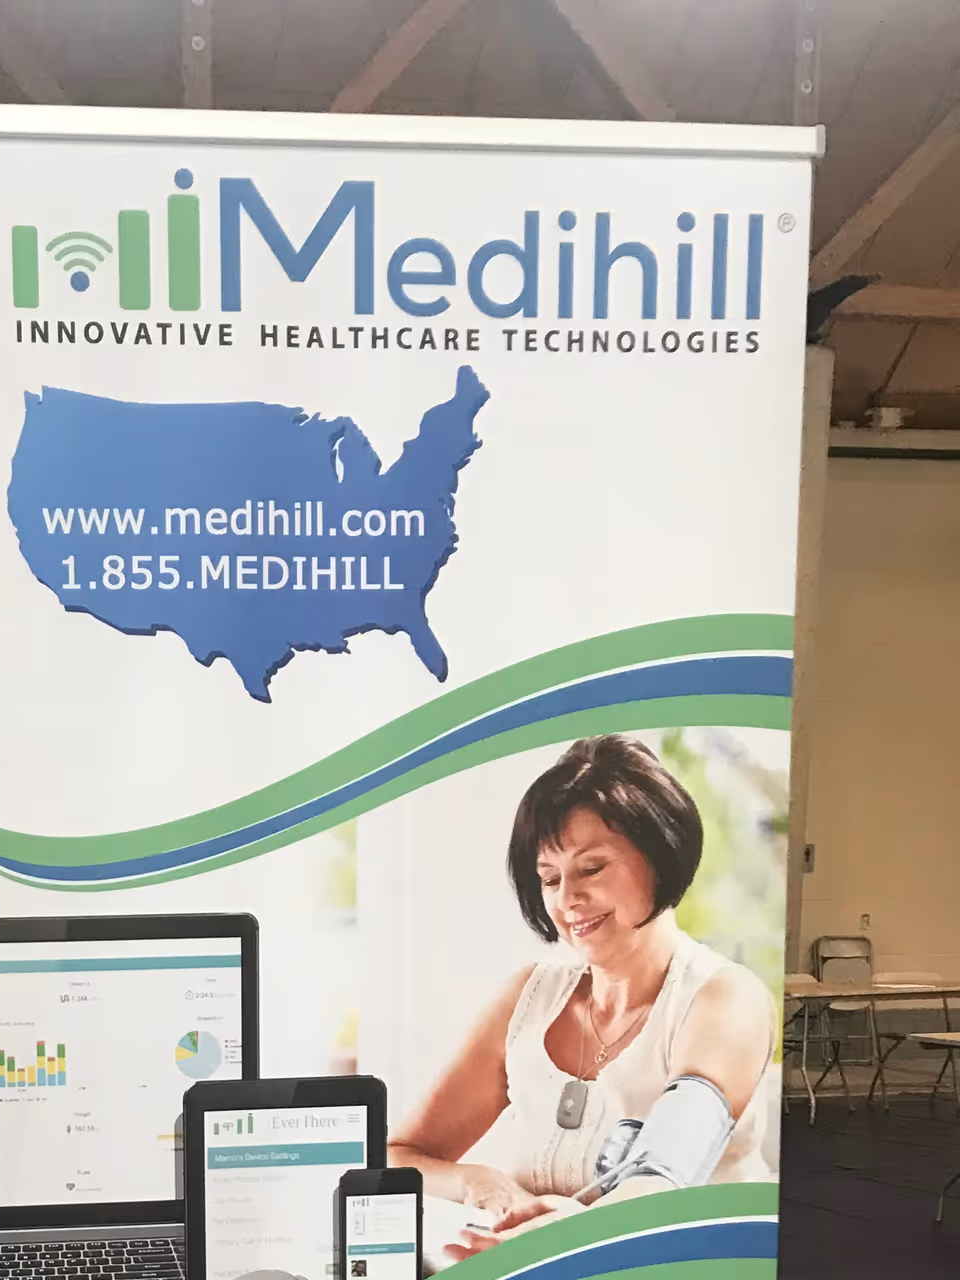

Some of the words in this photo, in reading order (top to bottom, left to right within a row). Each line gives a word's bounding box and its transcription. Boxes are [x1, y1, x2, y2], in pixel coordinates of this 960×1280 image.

[219, 177, 764, 320] Medihill
[17, 320, 233, 346] INNOVATIVE
[261, 324, 480, 352] HEALTHCARE
[502, 330, 759, 354] TECHNOLOGIES
[43, 500, 425, 537] www.medihill.com
[61, 554, 405, 592] 1.855.MEDIHILL
